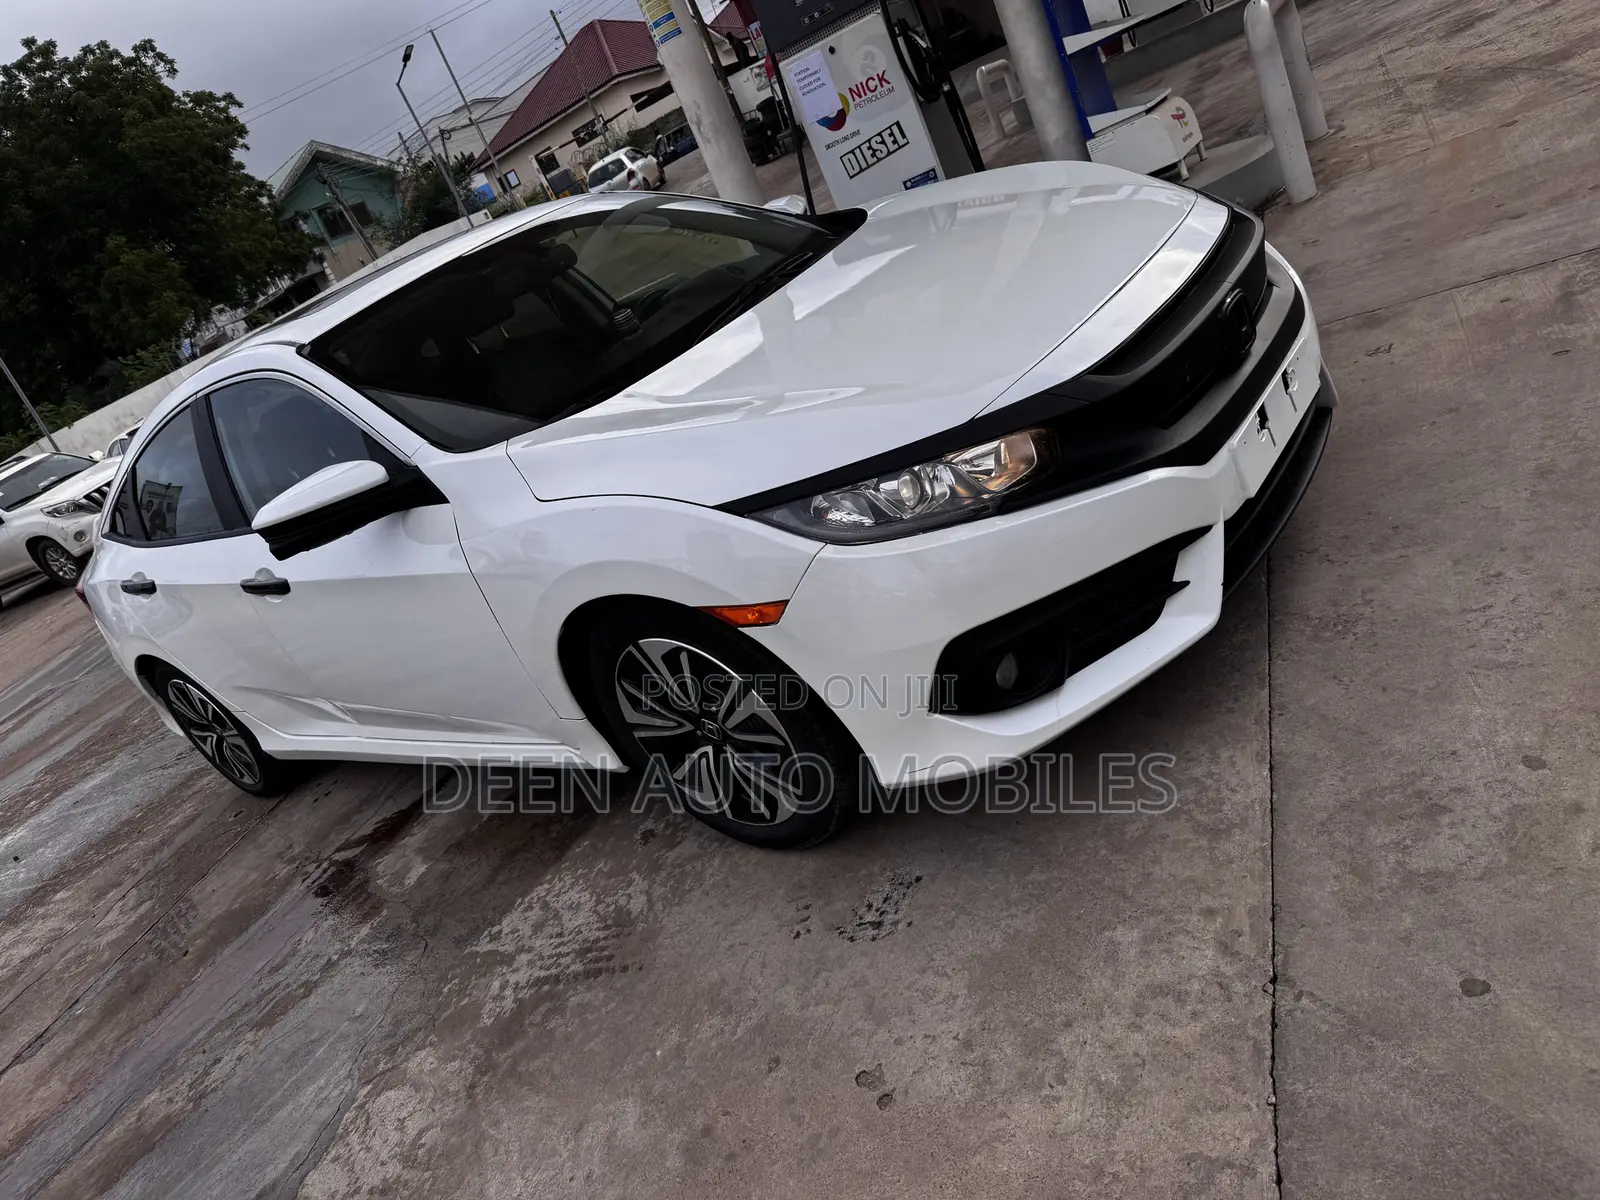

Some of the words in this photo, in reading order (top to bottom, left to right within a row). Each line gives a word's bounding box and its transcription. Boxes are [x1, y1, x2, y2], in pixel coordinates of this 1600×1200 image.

[793, 67, 810, 77] STATION
[799, 80, 813, 91] CLOSED
[812, 76, 821, 84] FOR
[848, 69, 892, 102] NICK
[853, 85, 896, 111] PETROLEUM
[824, 139, 841, 151] SMOOTH
[839, 134, 850, 145] LONG
[849, 128, 861, 140] DRIVE
[840, 122, 909, 178] DIESEL
